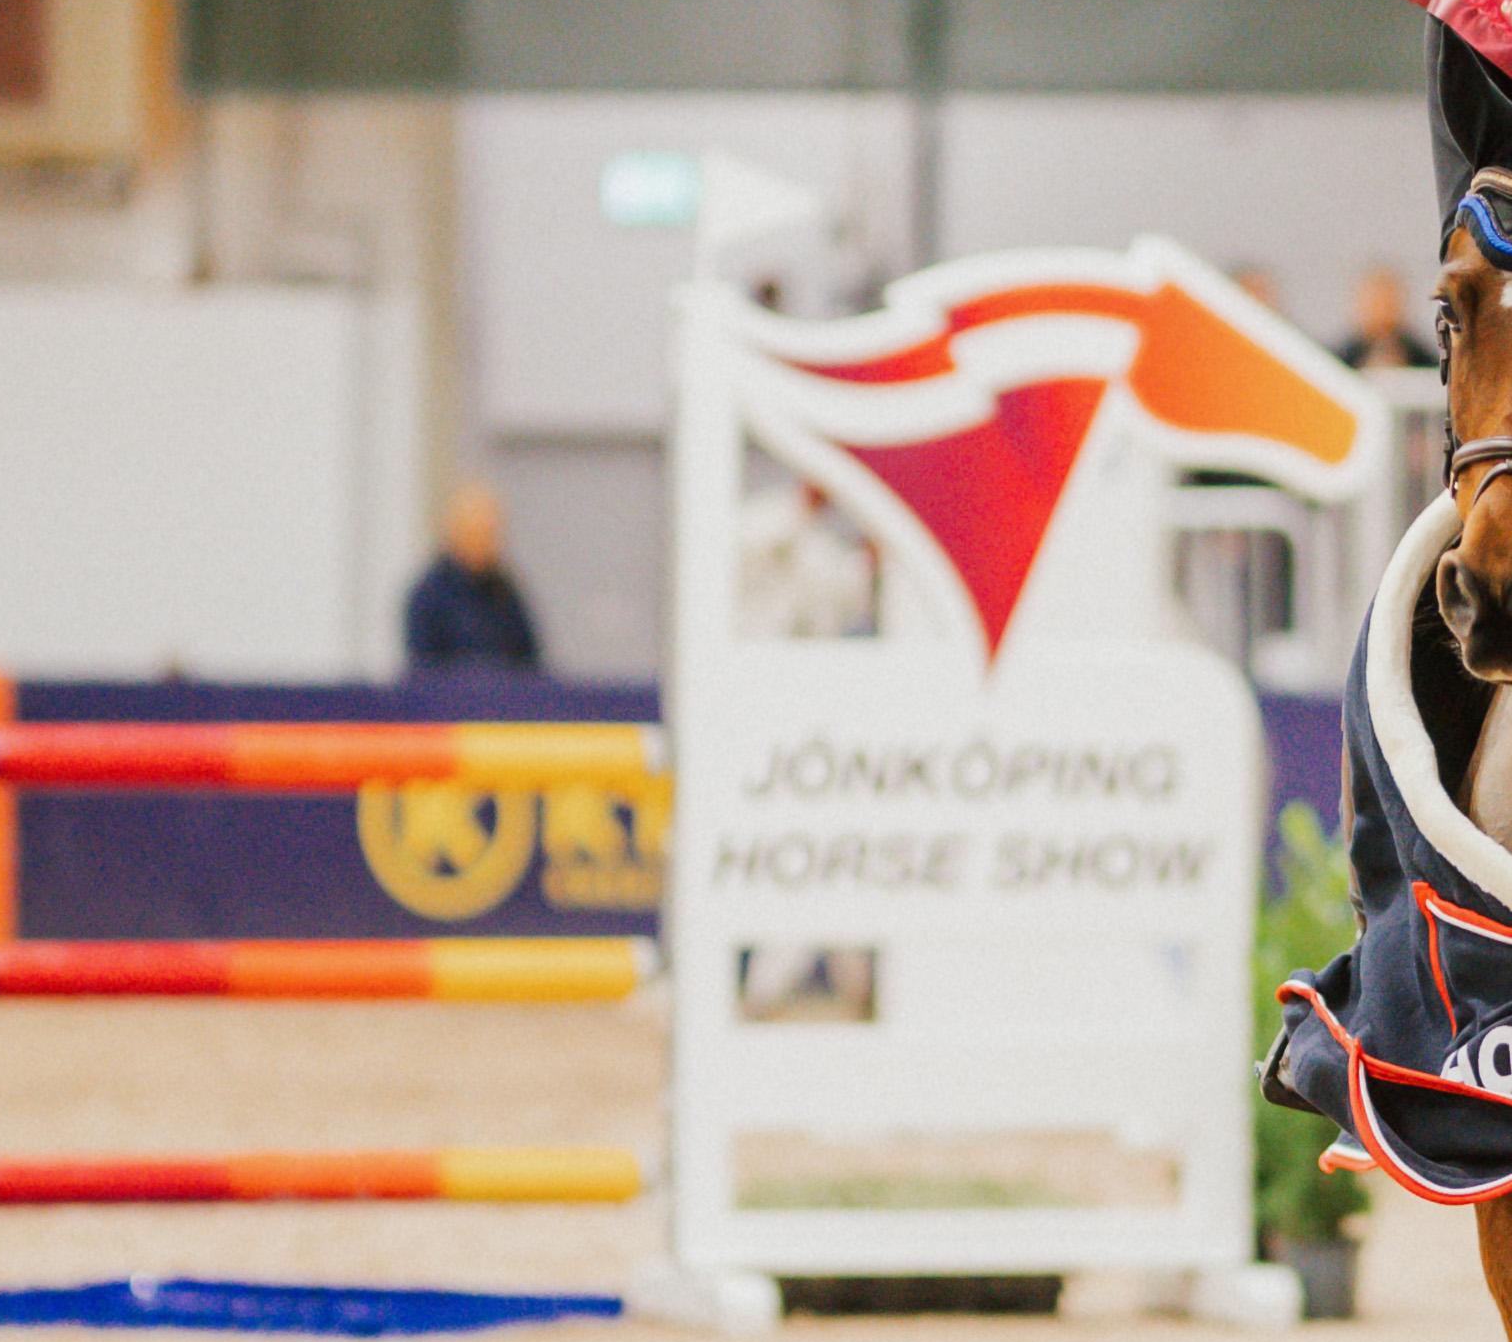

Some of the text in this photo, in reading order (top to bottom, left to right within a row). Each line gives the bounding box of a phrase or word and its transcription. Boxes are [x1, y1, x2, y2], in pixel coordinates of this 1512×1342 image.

[740, 735, 1182, 803] JÖNKÖPING
[712, 829, 966, 890] HORSE
[992, 829, 1216, 890] SHOW
